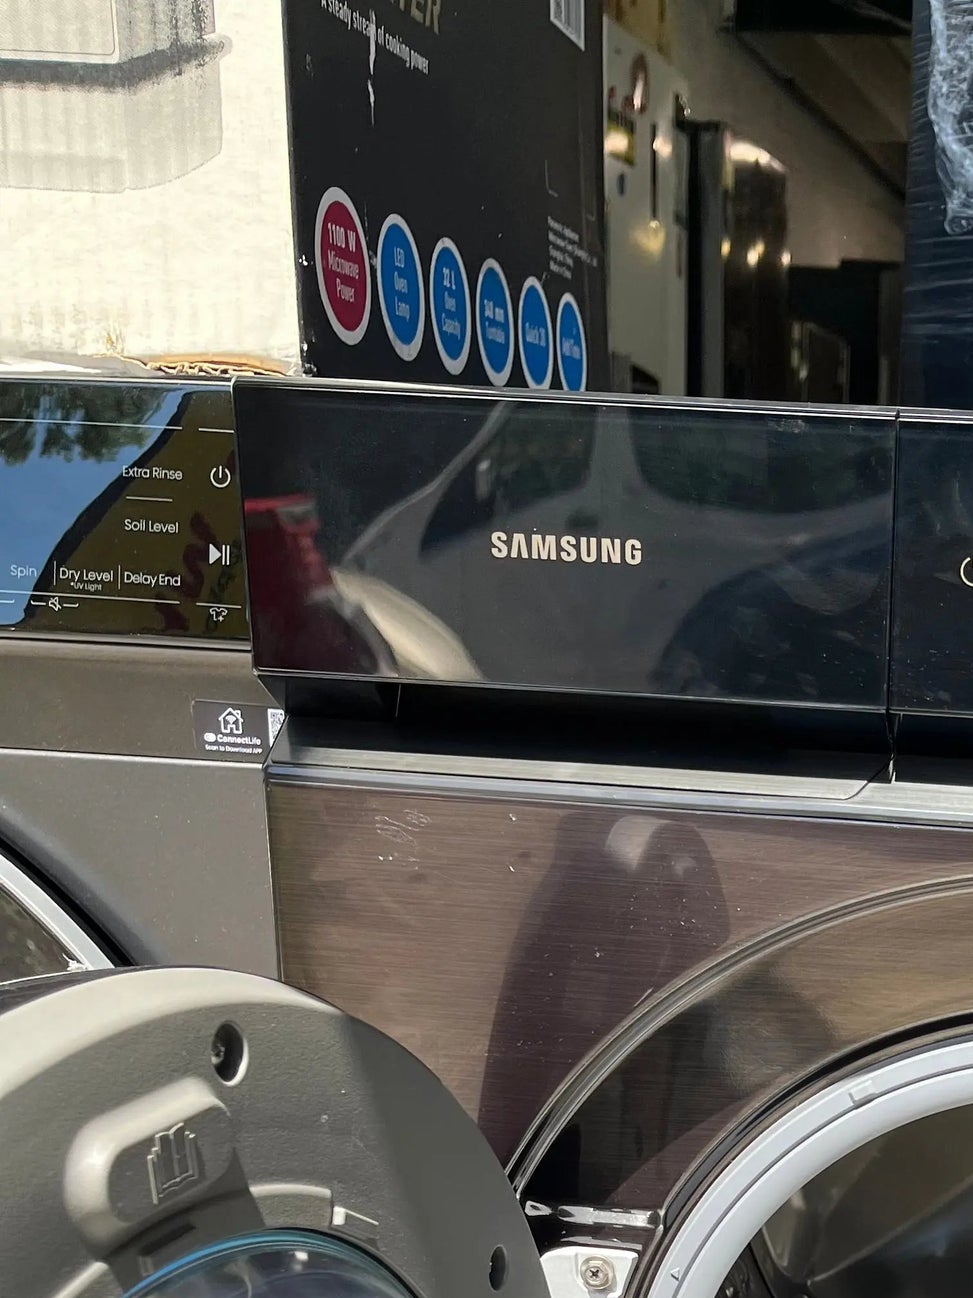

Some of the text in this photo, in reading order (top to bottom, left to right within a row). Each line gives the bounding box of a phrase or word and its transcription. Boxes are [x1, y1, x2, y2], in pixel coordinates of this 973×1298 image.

[377, 25, 385, 46] of
[385, 33, 410, 68] cooking
[410, 49, 429, 75] power
[327, 222, 356, 253] 1100 W
[327, 249, 359, 280] Microwave
[393, 246, 405, 268] LED
[336, 278, 355, 303] Power
[393, 271, 408, 294] Oven
[395, 296, 410, 322] Lamp
[122, 465, 183, 481] Extra Rinse
[124, 518, 179, 534] Soil Level
[490, 531, 642, 566] SAMSUNG
[10, 564, 37, 579] Spin
[59, 567, 114, 584] Dry Level
[124, 571, 181, 588] Delay End
[217, 734, 262, 746] ConnectLife
[226, 746, 252, 754] Download
